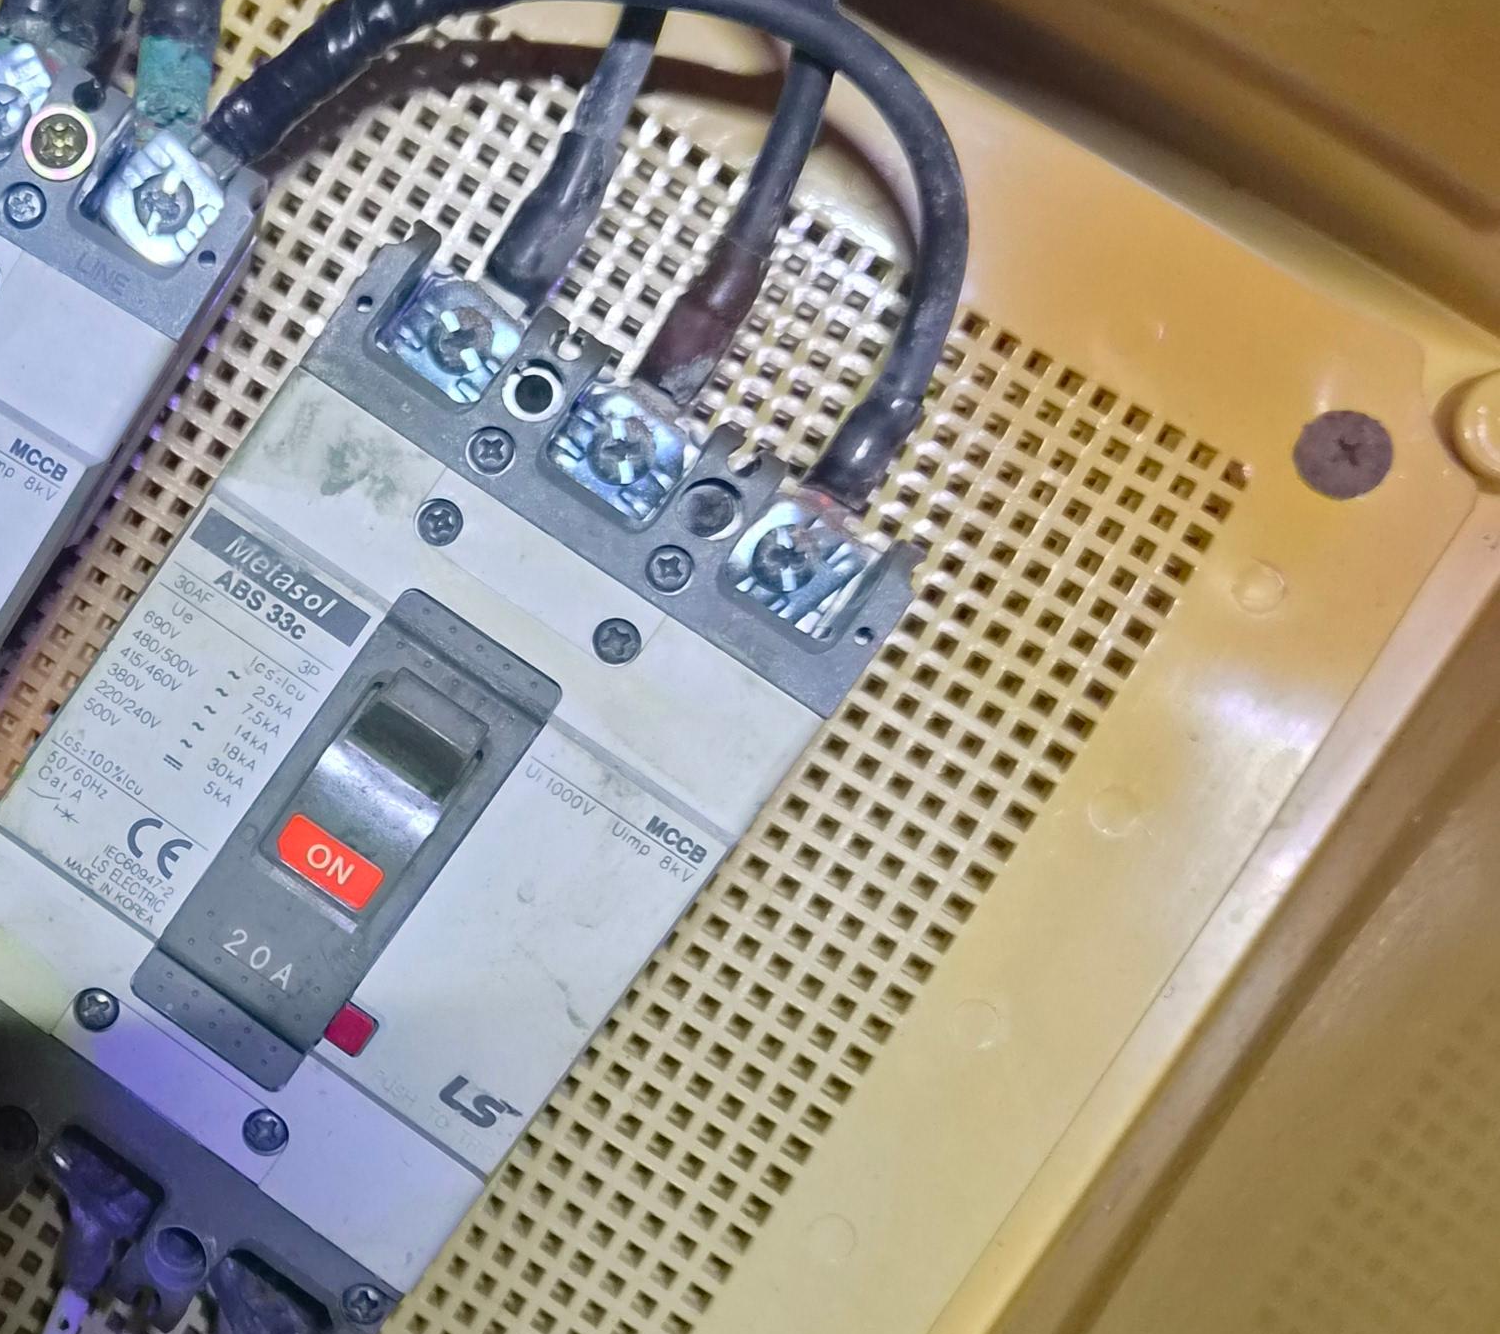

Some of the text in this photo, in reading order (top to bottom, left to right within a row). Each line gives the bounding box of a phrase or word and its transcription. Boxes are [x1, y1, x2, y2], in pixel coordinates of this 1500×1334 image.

[76, 251, 131, 297] LINE
[9, 438, 68, 482] MCCB
[23, 475, 60, 502] 8kV
[214, 569, 306, 640] ABS 33c
[224, 535, 338, 617] Metasol
[172, 601, 194, 625] Ue
[174, 574, 320, 677] 30AF 3P
[132, 629, 281, 737] 480/500V 7.5kA
[143, 610, 293, 719] 690V 2.5kA
[107, 662, 257, 772] 380V 18kA
[120, 647, 269, 755] 415/460V 14kA
[84, 697, 232, 807] 500V 5kA
[94, 680, 244, 790] 220/240V 30kA
[47, 750, 108, 800] 50/60Hz
[127, 817, 193, 880] CE
[525, 763, 695, 883] Ui 1000V Uimp 8kV
[645, 815, 708, 864] MCCB
[63, 856, 154, 924] MADE IN KOREA
[91, 855, 167, 914] LS ELECTRIC
[103, 844, 175, 899] IEC60947-2
[306, 844, 356, 885] ON
[222, 929, 294, 991] 20A
[439, 1075, 523, 1128] LS
